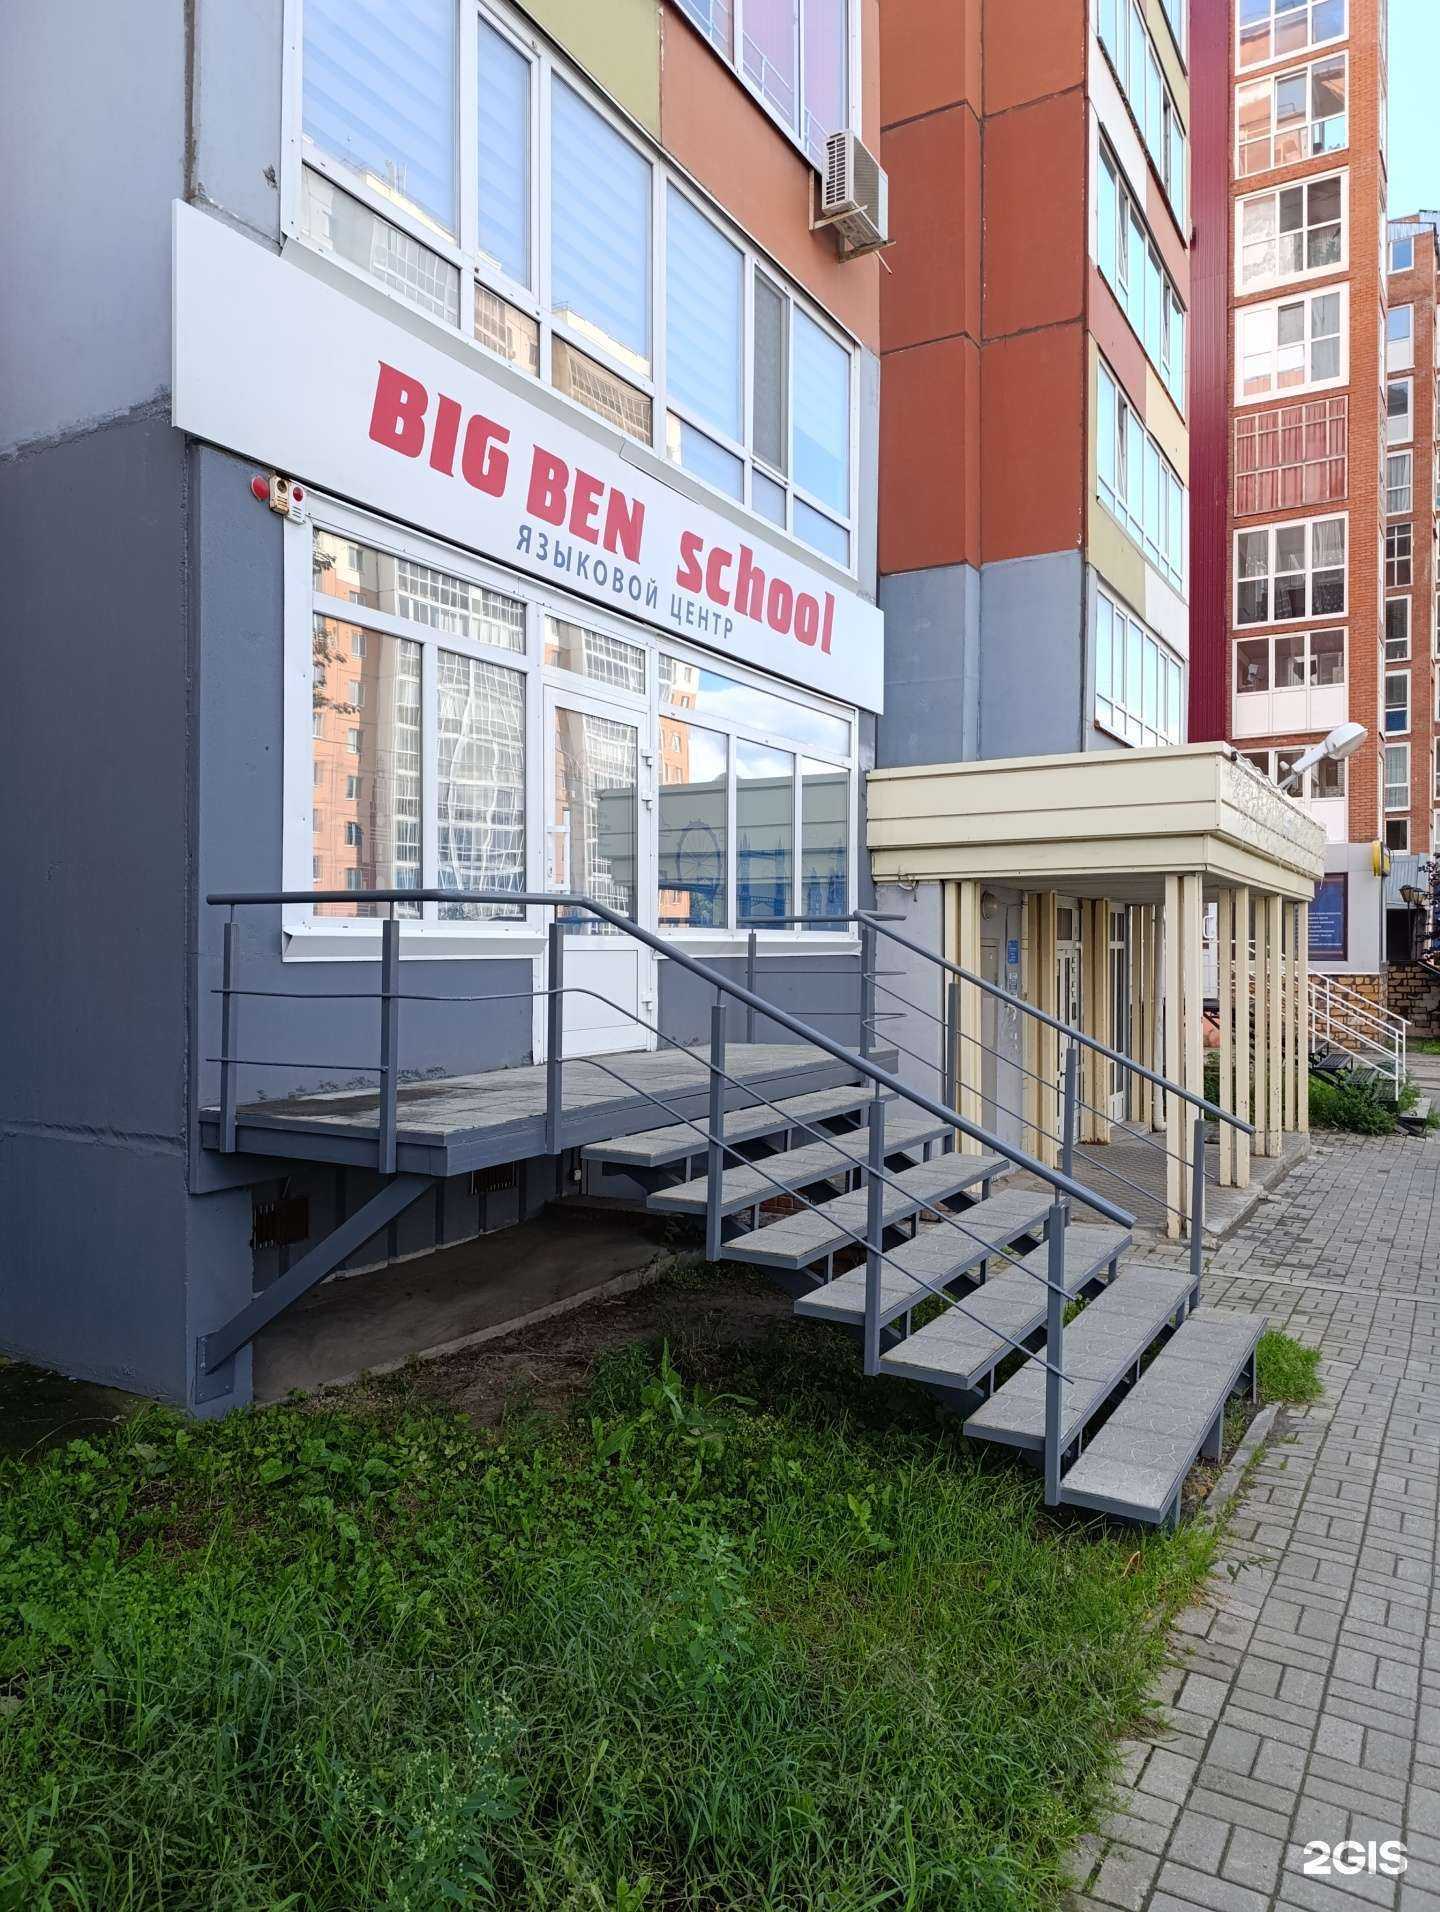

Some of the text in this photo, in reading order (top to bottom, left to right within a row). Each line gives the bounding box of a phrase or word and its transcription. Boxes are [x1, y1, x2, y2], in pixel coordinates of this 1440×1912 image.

[369, 361, 511, 498] BIG
[527, 445, 645, 564] BEN
[516, 524, 734, 639] ЯЗЫКОВОЙ ЦЕНТР
